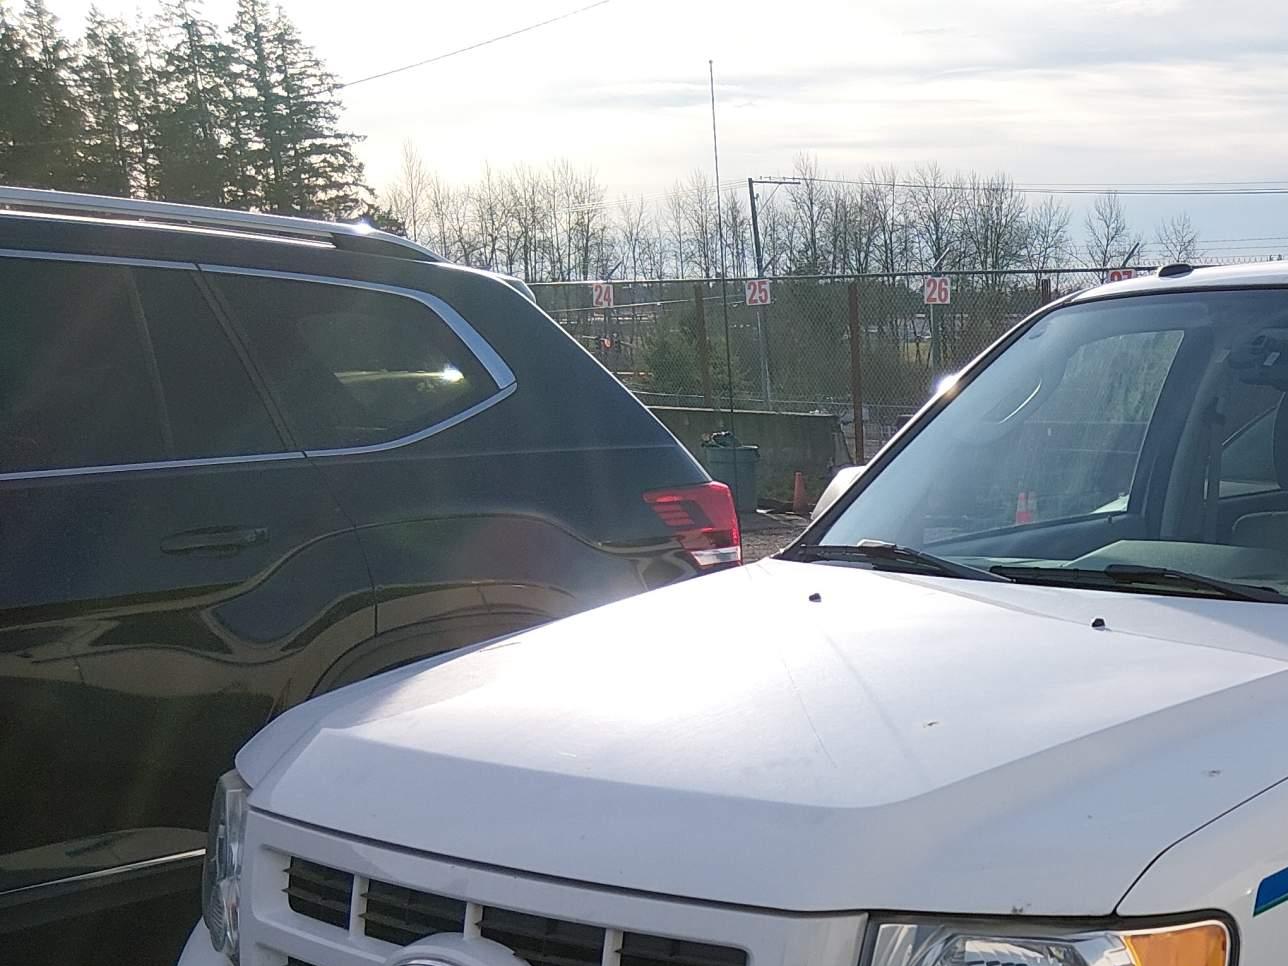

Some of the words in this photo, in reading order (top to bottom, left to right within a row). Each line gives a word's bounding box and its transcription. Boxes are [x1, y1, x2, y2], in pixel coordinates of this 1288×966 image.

[594, 285, 611, 305] 24
[748, 281, 768, 304] 25
[927, 278, 949, 303] 26
